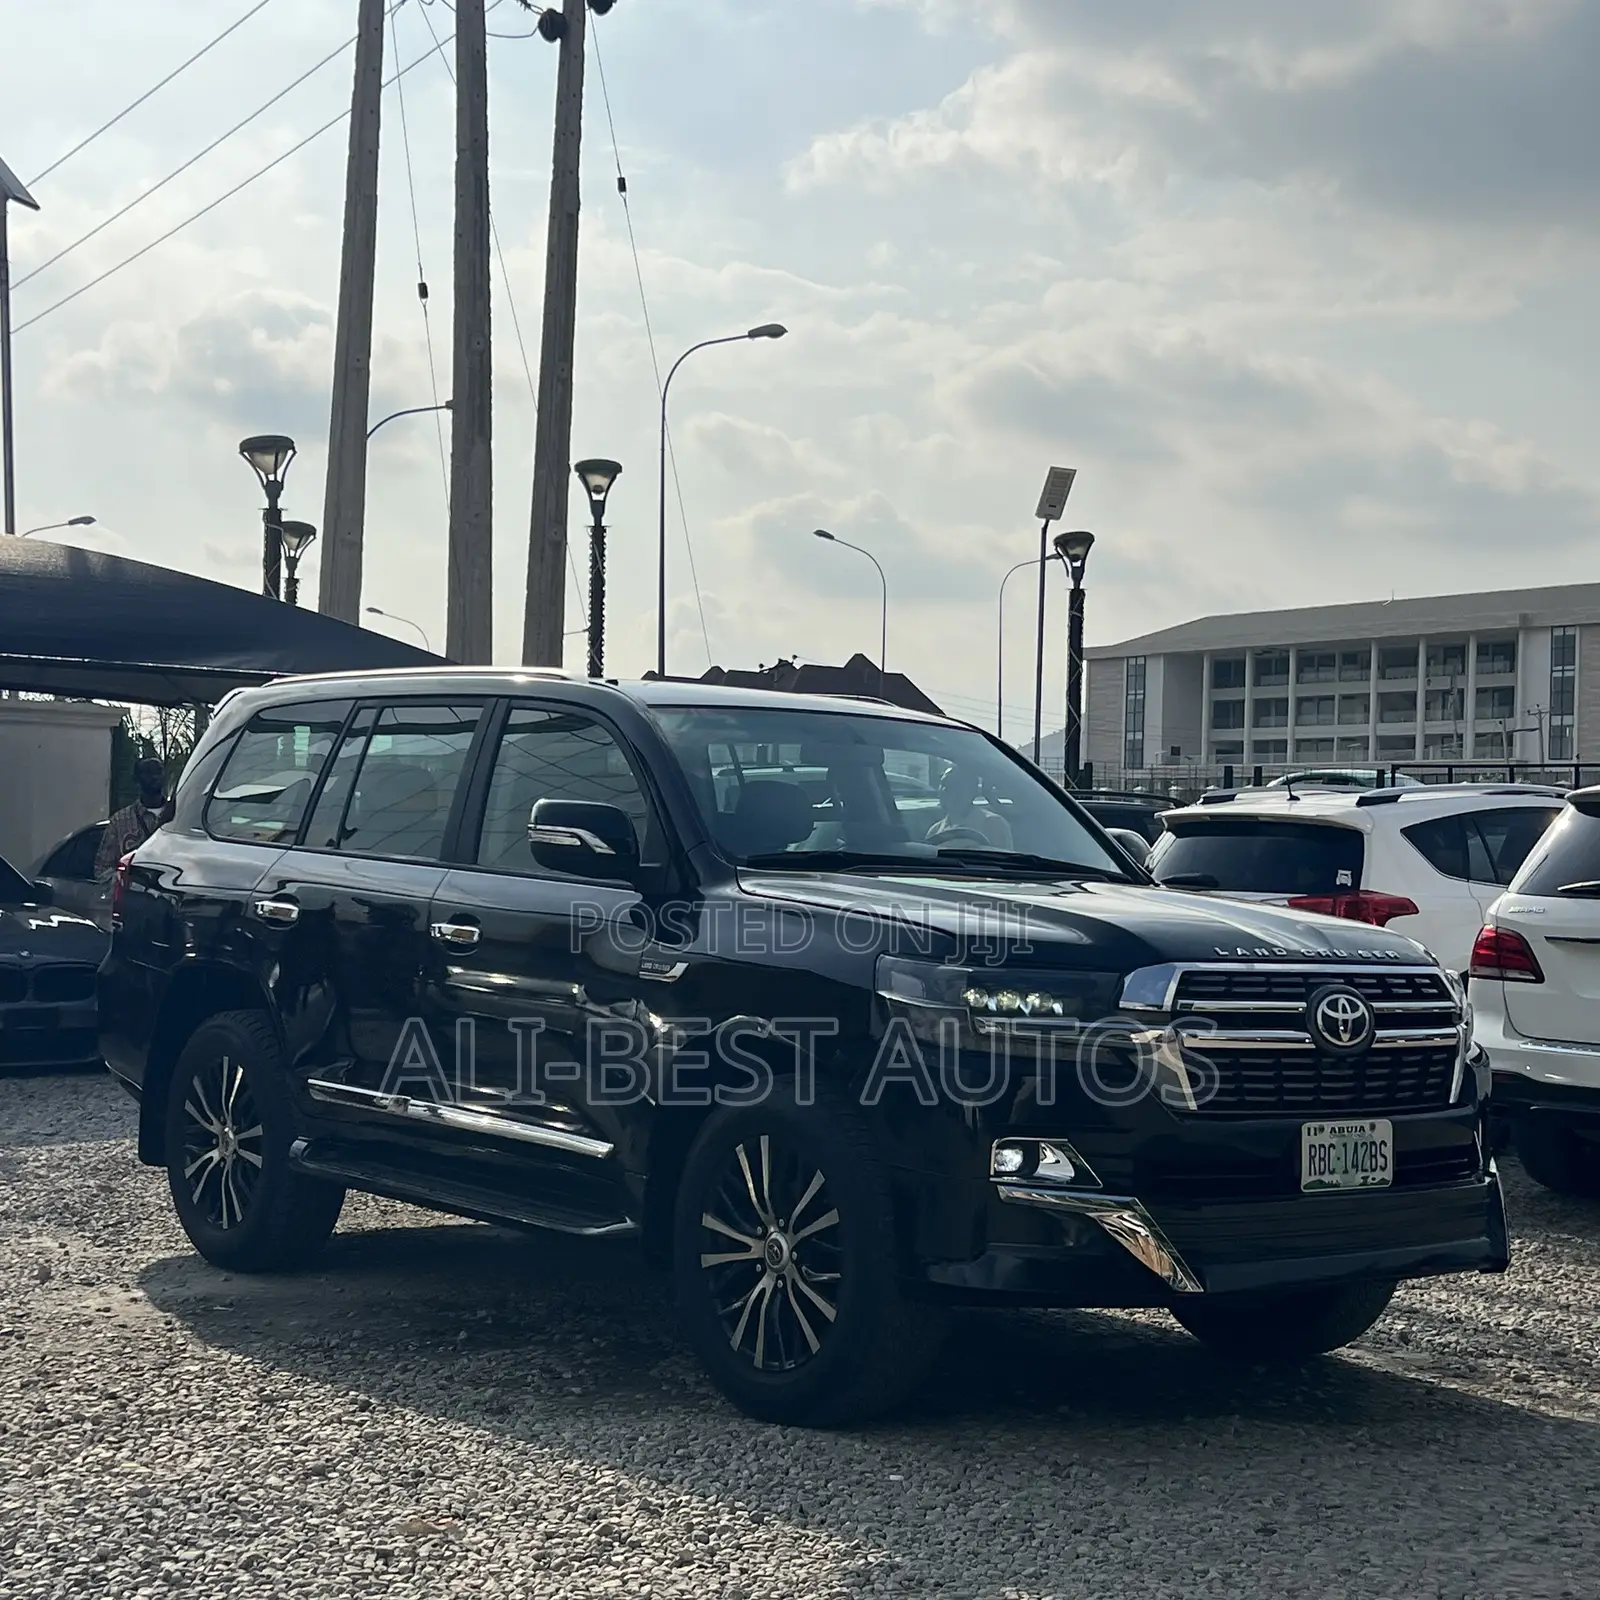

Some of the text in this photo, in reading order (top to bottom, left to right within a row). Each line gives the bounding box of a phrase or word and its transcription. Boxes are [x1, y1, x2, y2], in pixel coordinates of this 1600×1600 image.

[1214, 946, 1400, 959] LAND CRUSER
[1329, 1125, 1366, 1134] ABUJA
